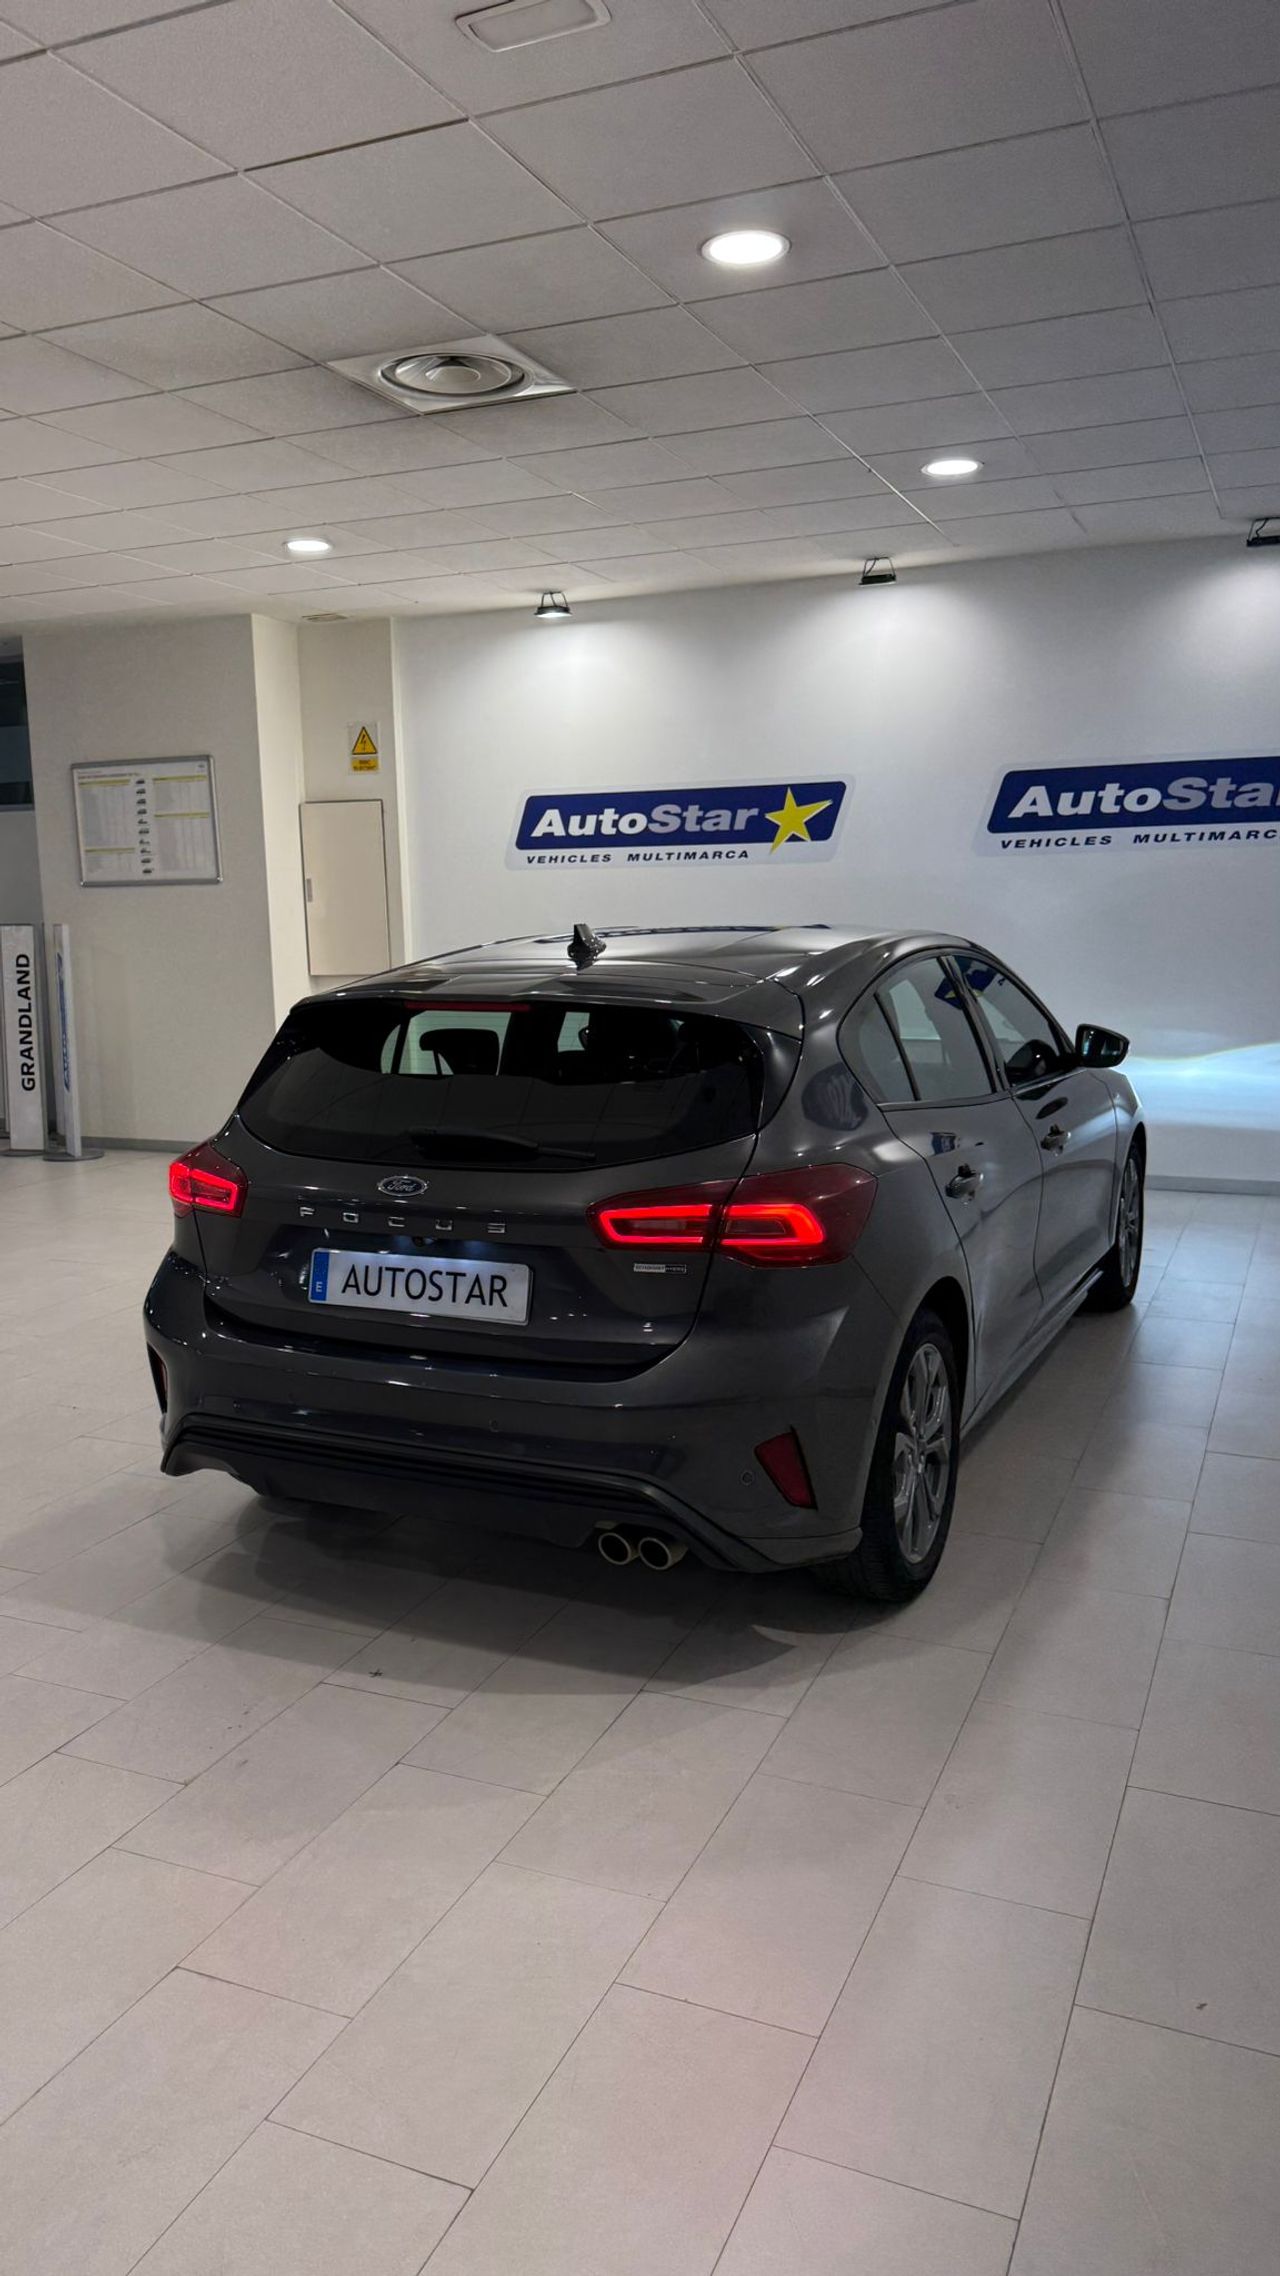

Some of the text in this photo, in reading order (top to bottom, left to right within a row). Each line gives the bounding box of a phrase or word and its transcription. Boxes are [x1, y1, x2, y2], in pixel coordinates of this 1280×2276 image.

[1007, 776, 1280, 819] AutoSta
[530, 804, 759, 838] AutoStar
[1001, 829, 1280, 849] VEHICLES MULTIMARC
[526, 850, 750, 864] VEHICLES MULTIMARCA
[15, 953, 36, 1092] GRANDLAND
[387, 1179, 417, 1192] Ford
[299, 1206, 506, 1234] FOCUS
[315, 1281, 323, 1293] E
[341, 1263, 508, 1308] AUTOSTAR
